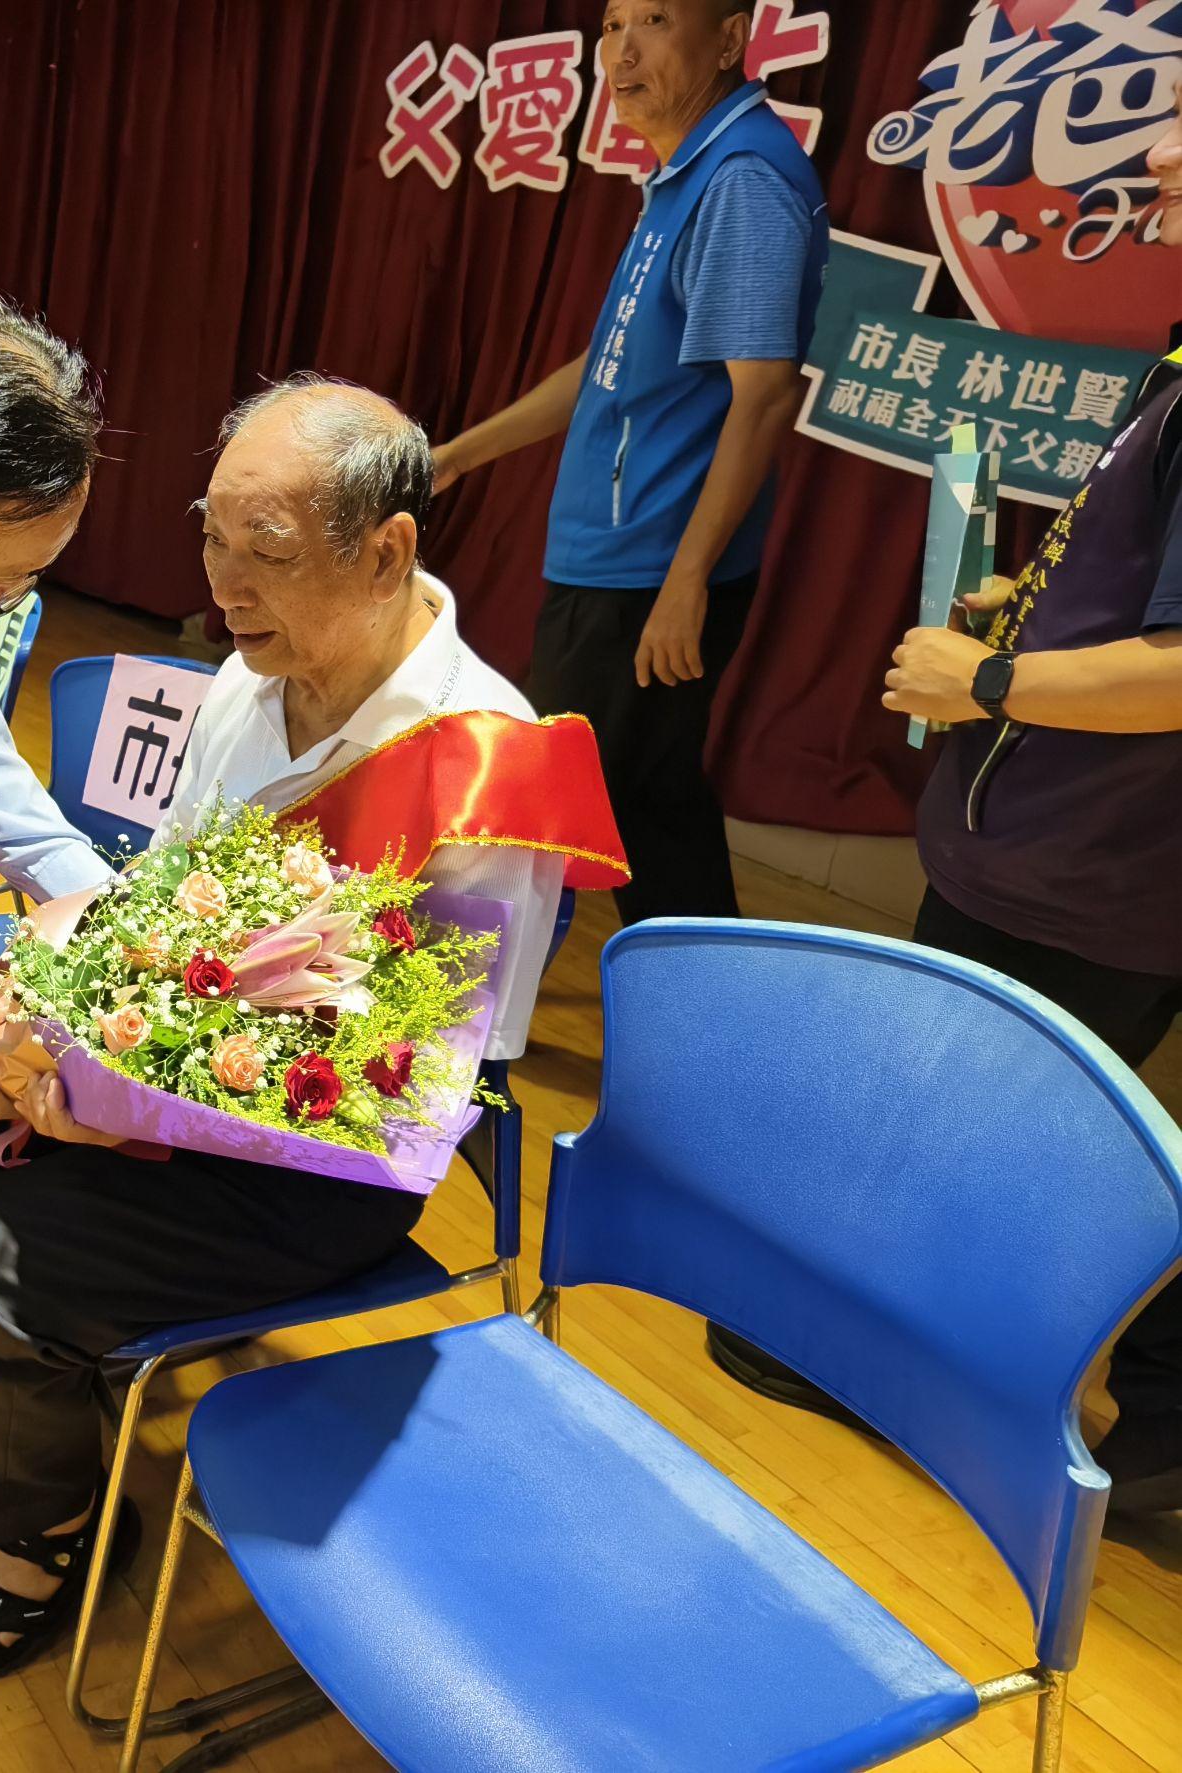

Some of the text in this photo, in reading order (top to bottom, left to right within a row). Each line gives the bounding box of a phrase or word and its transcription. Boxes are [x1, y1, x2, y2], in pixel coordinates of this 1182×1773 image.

[848, 322, 1129, 428] 市長 林世賢
[827, 378, 1103, 482] 祝福全天下父親
